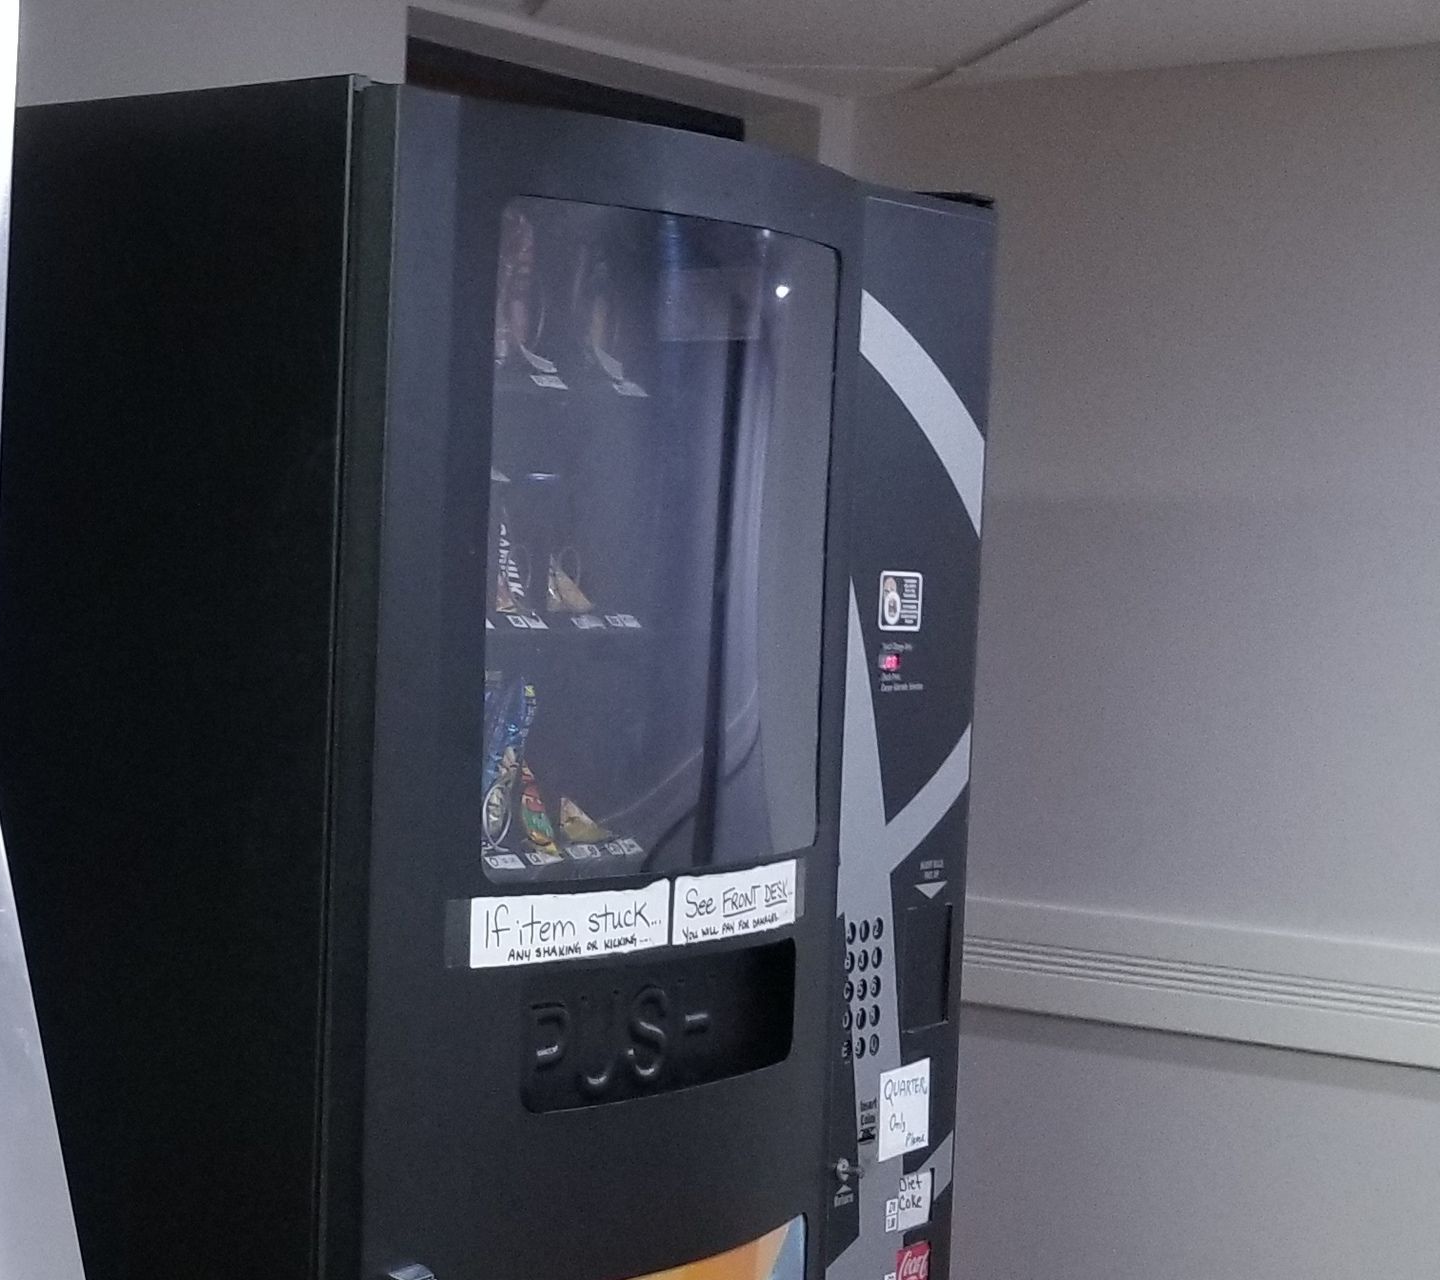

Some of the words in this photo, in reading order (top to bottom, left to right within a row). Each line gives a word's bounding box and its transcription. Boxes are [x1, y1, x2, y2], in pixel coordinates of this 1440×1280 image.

[685, 887, 717, 918] See
[722, 885, 762, 914] FRONT
[484, 903, 511, 949] If
[516, 904, 576, 946] item
[507, 947, 531, 962] ANY
[535, 942, 582, 958] SHAKING
[586, 941, 599, 952] OR
[899, 1174, 923, 1192] Diet
[899, 1194, 923, 1211] Coke
